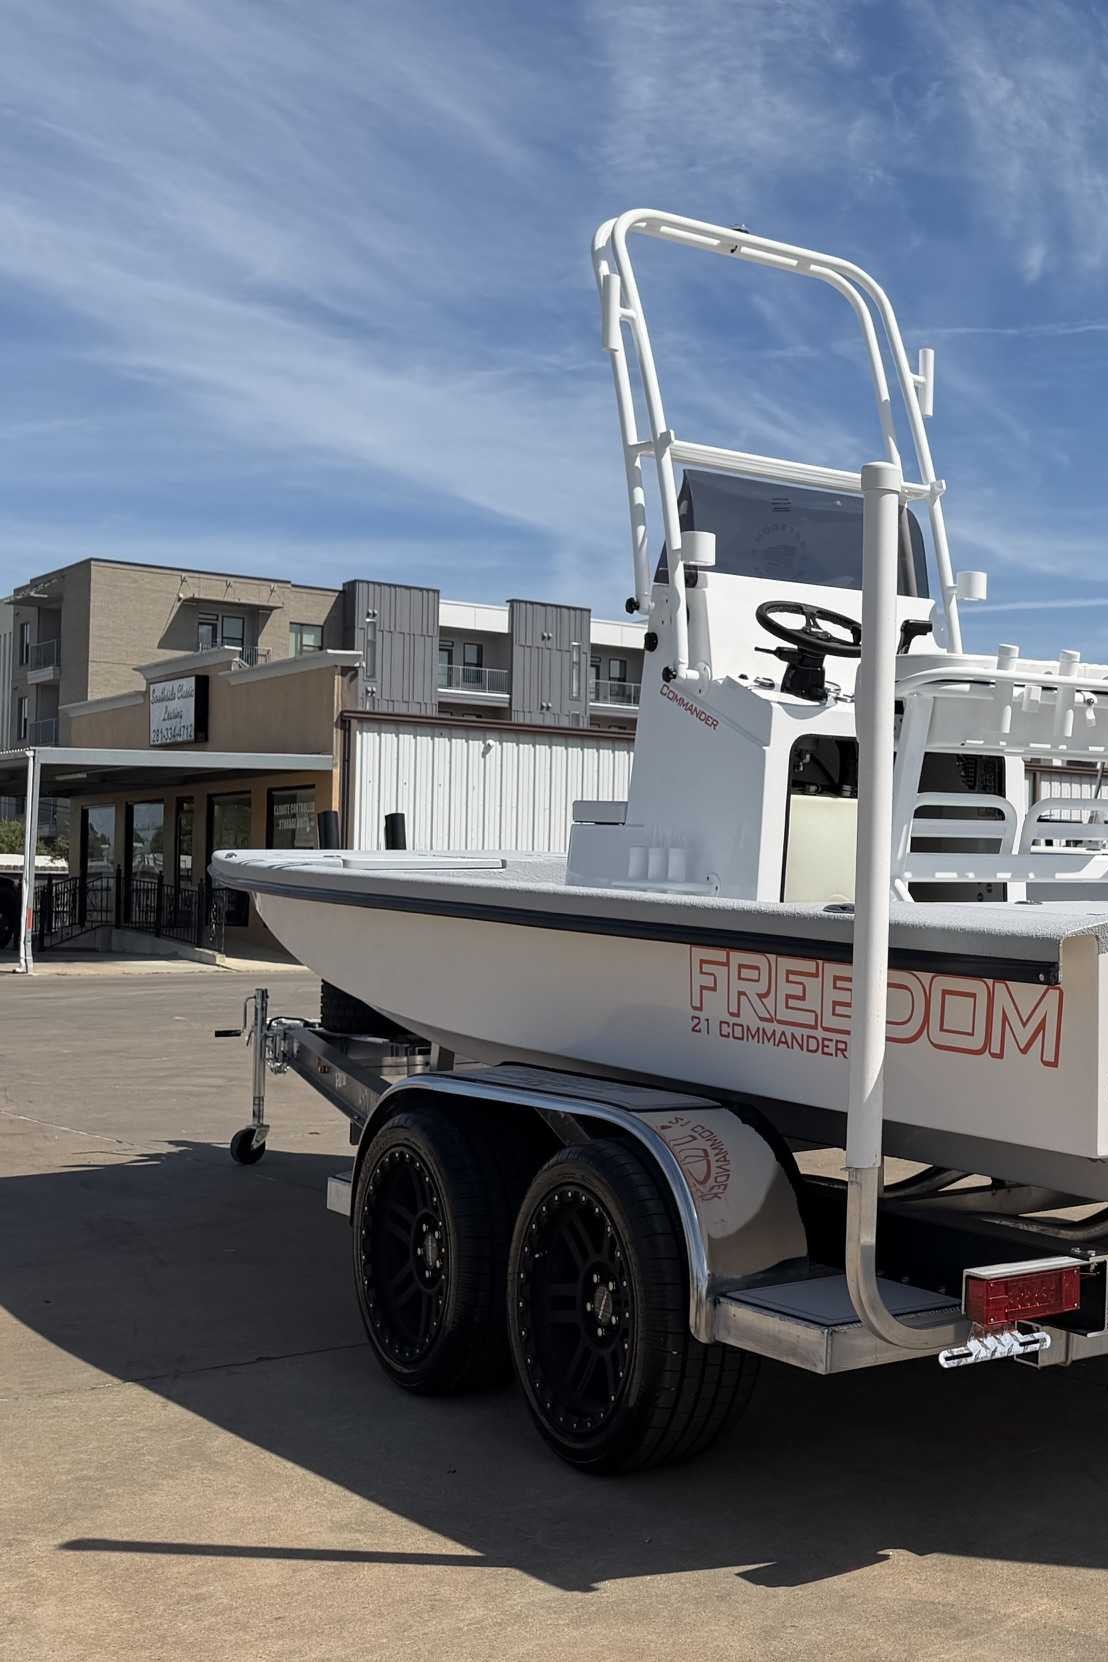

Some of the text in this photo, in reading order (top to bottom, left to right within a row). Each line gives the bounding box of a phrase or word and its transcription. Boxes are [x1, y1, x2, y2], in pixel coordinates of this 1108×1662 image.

[660, 683, 720, 731] COMMANDER
[689, 945, 1064, 1068] FREEDOM
[690, 1015, 848, 1059] 21 COMMANDER
